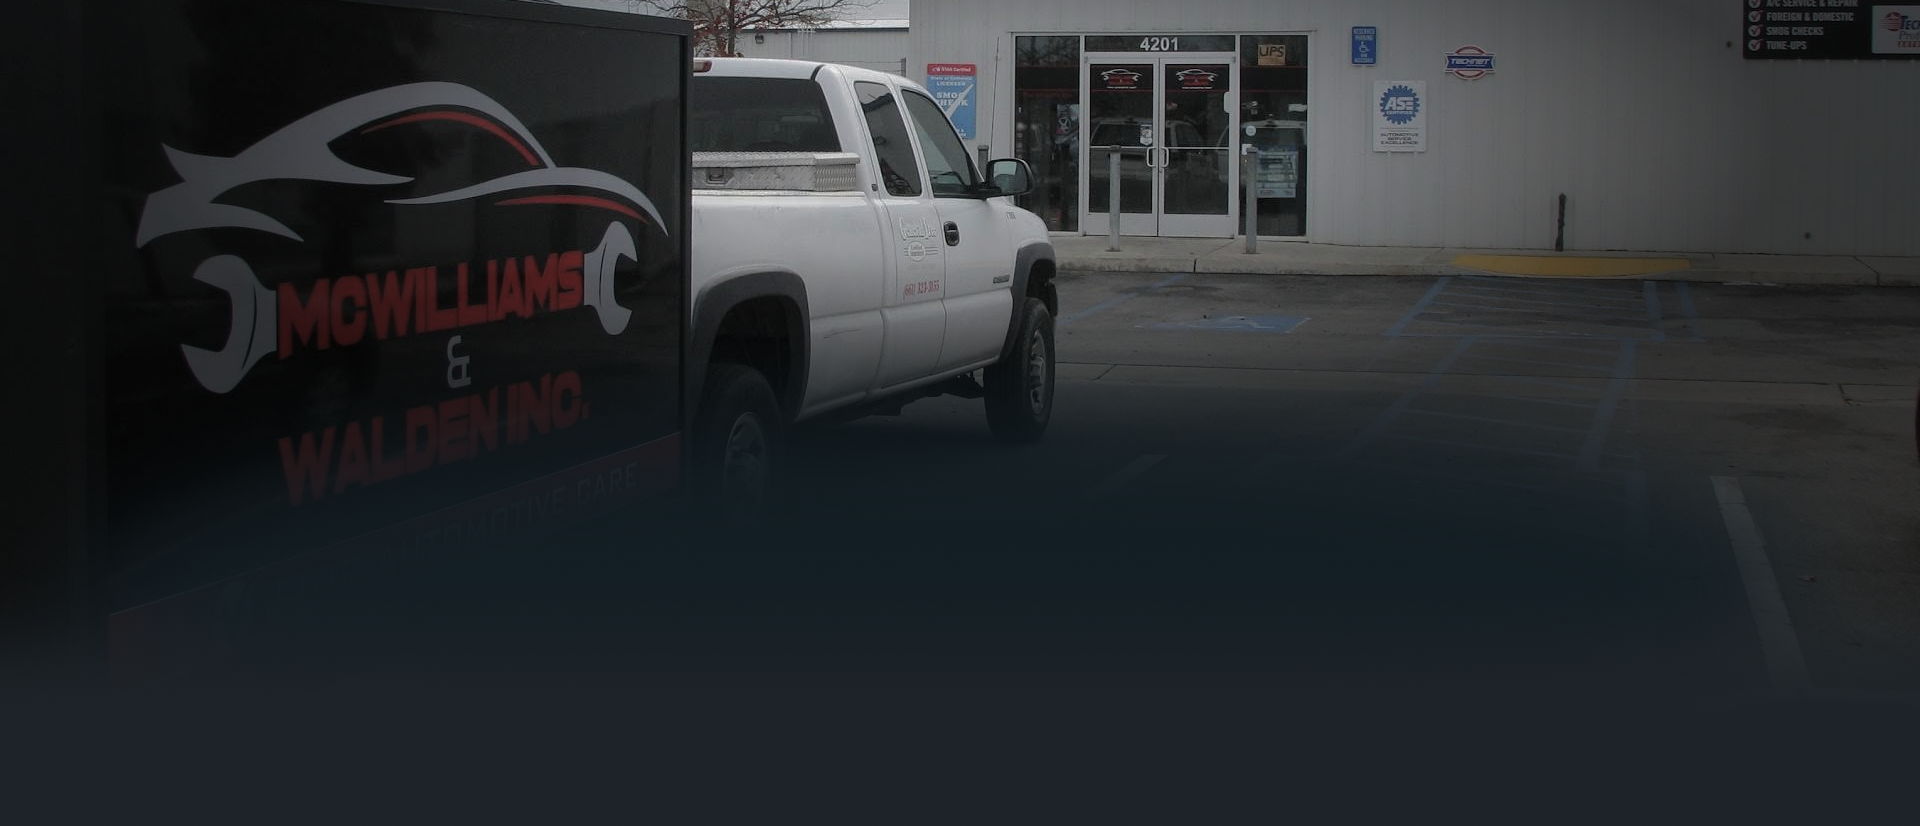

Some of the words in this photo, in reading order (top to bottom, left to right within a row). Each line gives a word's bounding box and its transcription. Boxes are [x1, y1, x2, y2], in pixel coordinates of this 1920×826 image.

[1766, 12, 1803, 22] FOREIGN
[1804, 12, 1811, 22] &
[1812, 12, 1855, 22] DOMESTIC
[1766, 26, 1790, 36] SMOG
[1791, 26, 1824, 36] CHECKS
[1140, 37, 1179, 51] 4201
[1766, 40, 1808, 50] TUNE-UPS
[1259, 46, 1285, 58] UPS
[1384, 96, 1415, 111] ASE
[278, 250, 583, 360] MCWILLIAMS
[447, 334, 472, 389] &
[277, 385, 499, 507] WALDEN
[506, 370, 591, 446] INC.
[576, 461, 640, 506] CARE
